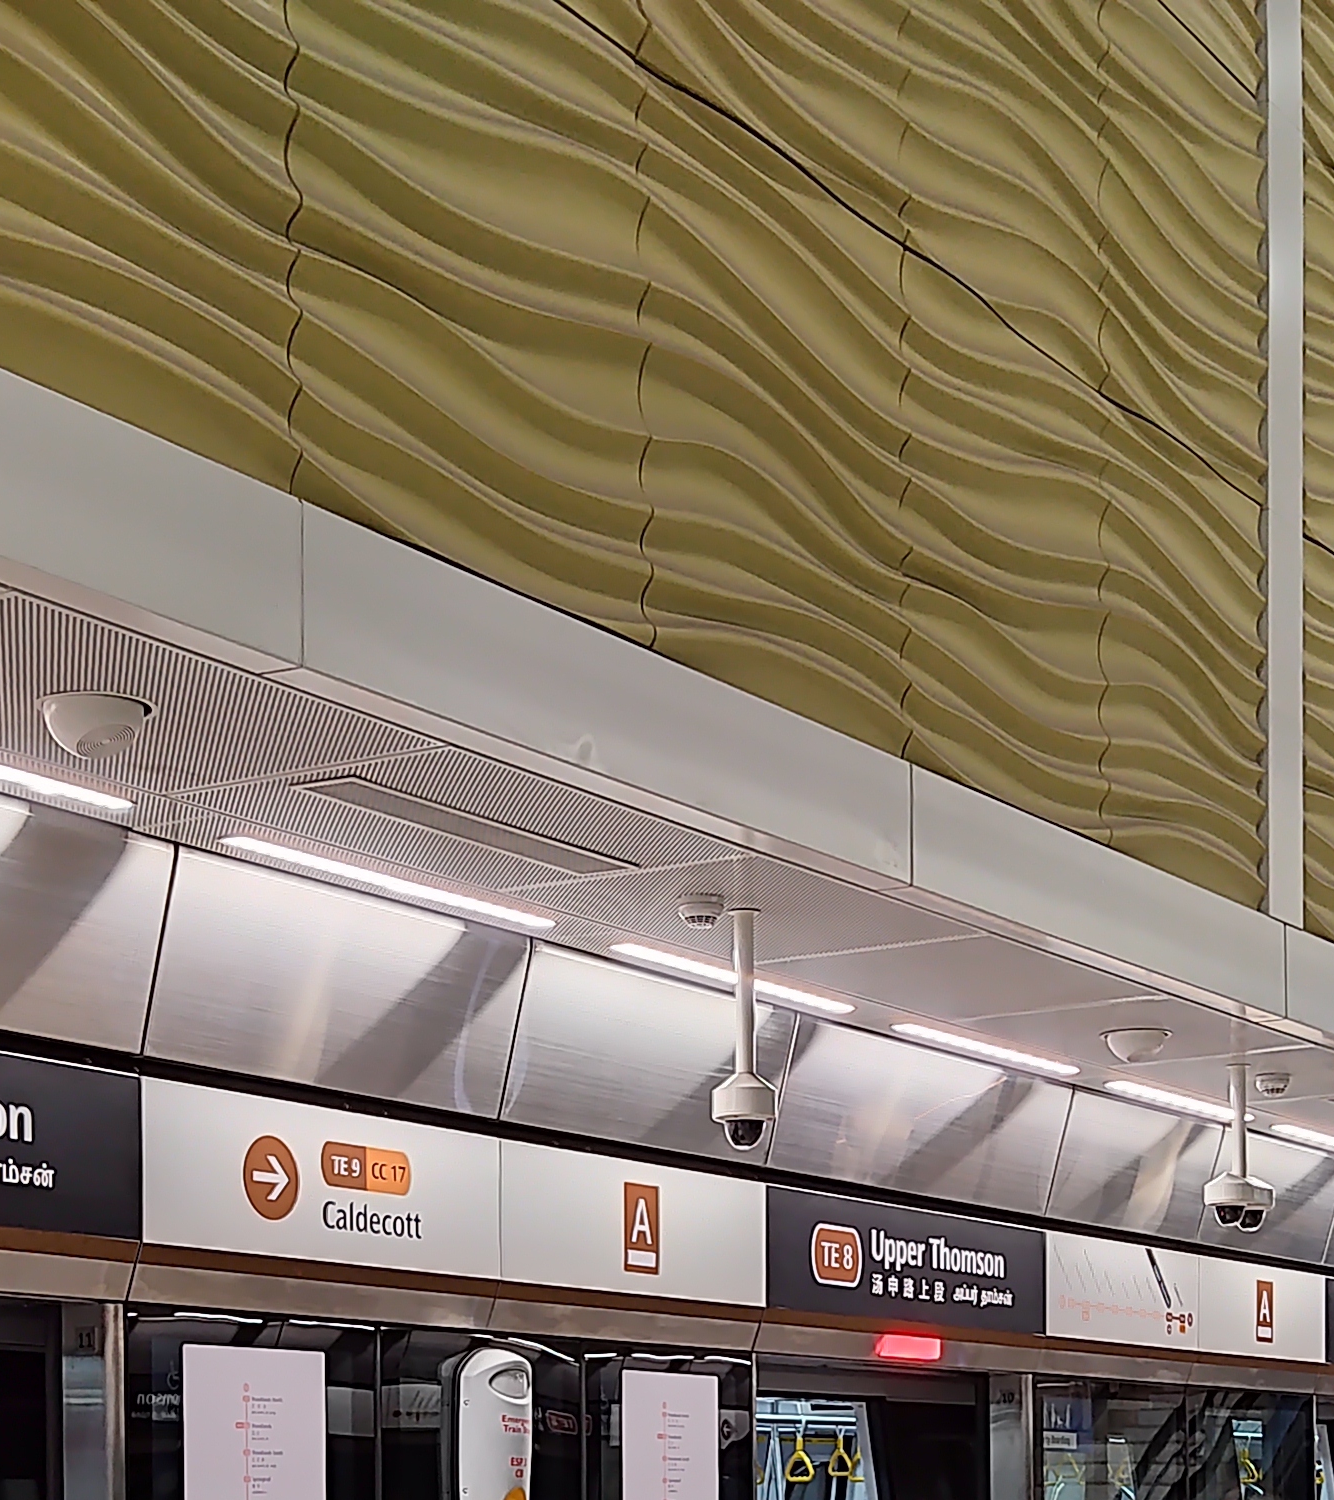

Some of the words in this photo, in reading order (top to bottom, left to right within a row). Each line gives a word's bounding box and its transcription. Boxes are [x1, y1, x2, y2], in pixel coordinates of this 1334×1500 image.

[331, 1153, 350, 1176] TE
[351, 1158, 360, 1178] 9
[370, 1161, 388, 1181] CC
[390, 1164, 406, 1184] 17
[322, 1200, 422, 1239] Caldecott
[631, 1198, 652, 1245] A
[820, 1241, 840, 1268] TE
[843, 1246, 853, 1270] 8
[870, 1229, 925, 1272] Upper
[929, 1237, 1005, 1278] Thomson
[1259, 1290, 1270, 1323] A
